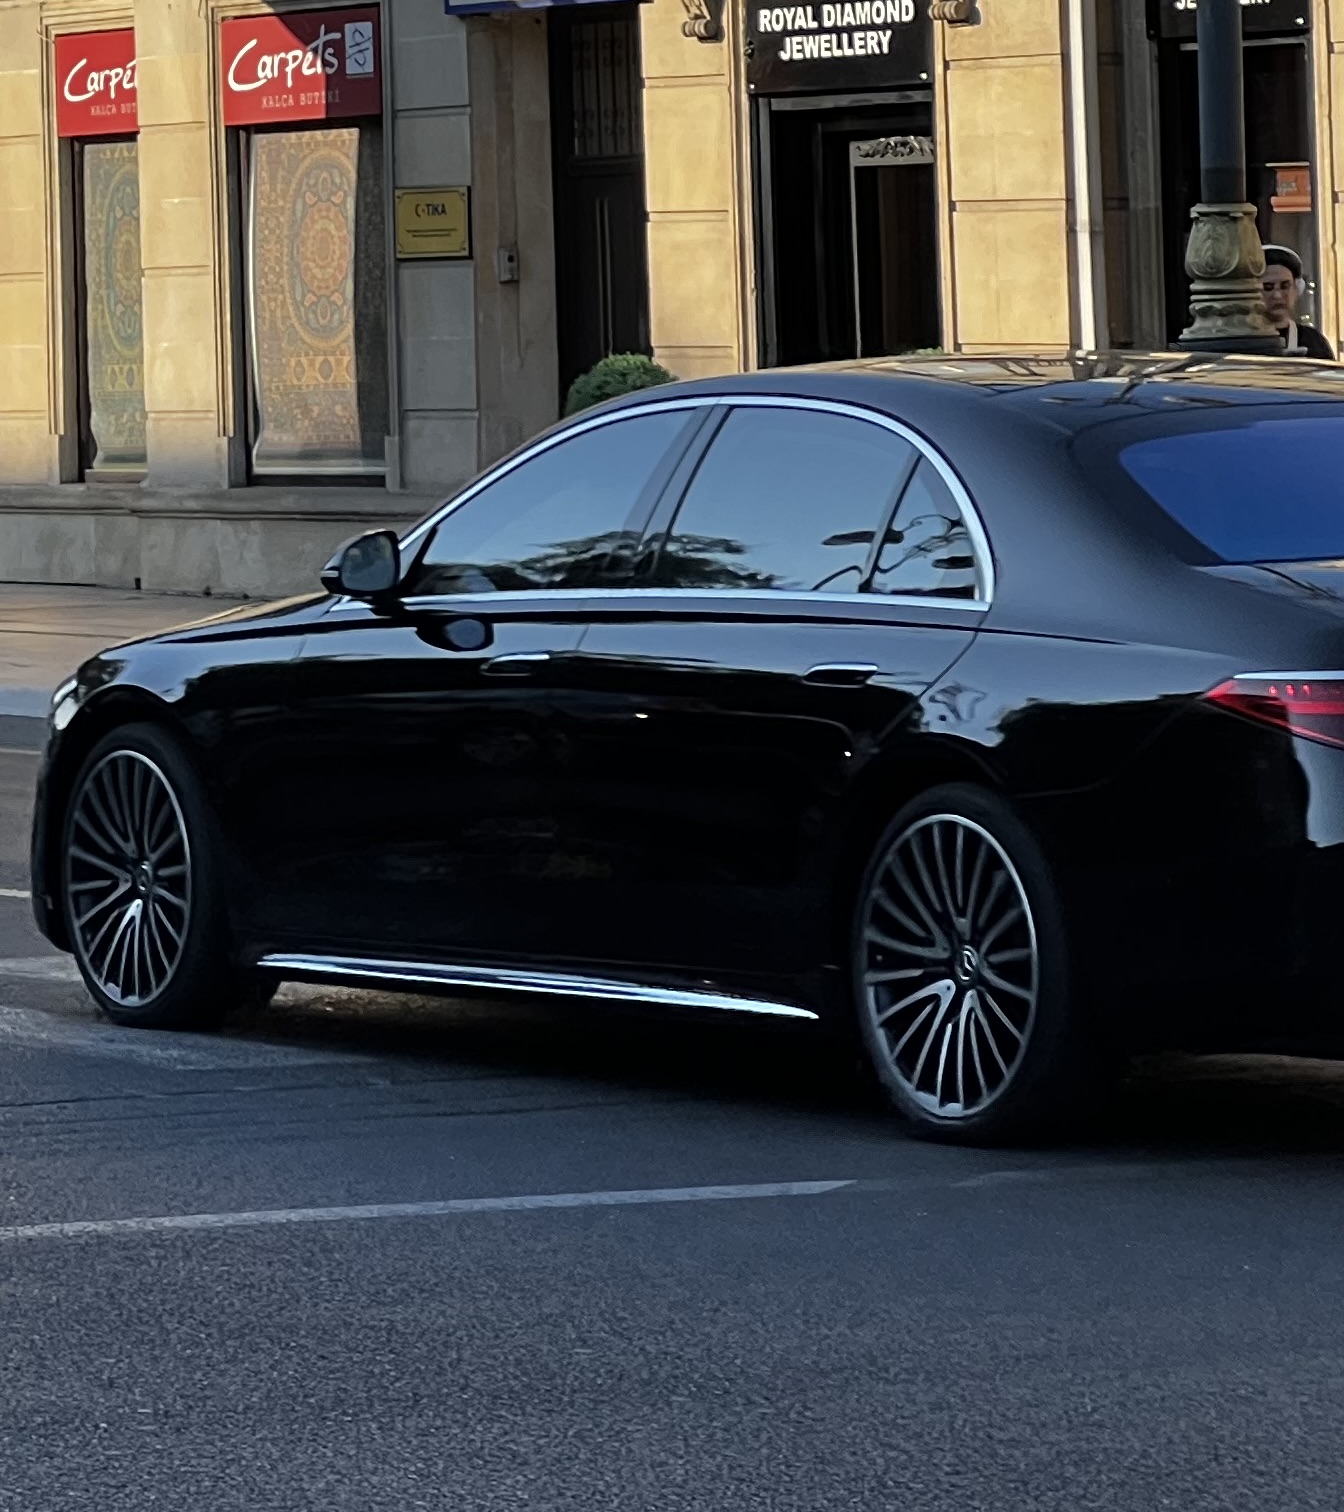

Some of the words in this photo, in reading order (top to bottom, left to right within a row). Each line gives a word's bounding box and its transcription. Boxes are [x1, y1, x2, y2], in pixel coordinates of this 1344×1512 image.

[757, 5, 819, 32] ROYAL
[227, 24, 342, 92] Carpets
[778, 30, 893, 61] JEWELLERY
[63, 58, 138, 102] Carpe
